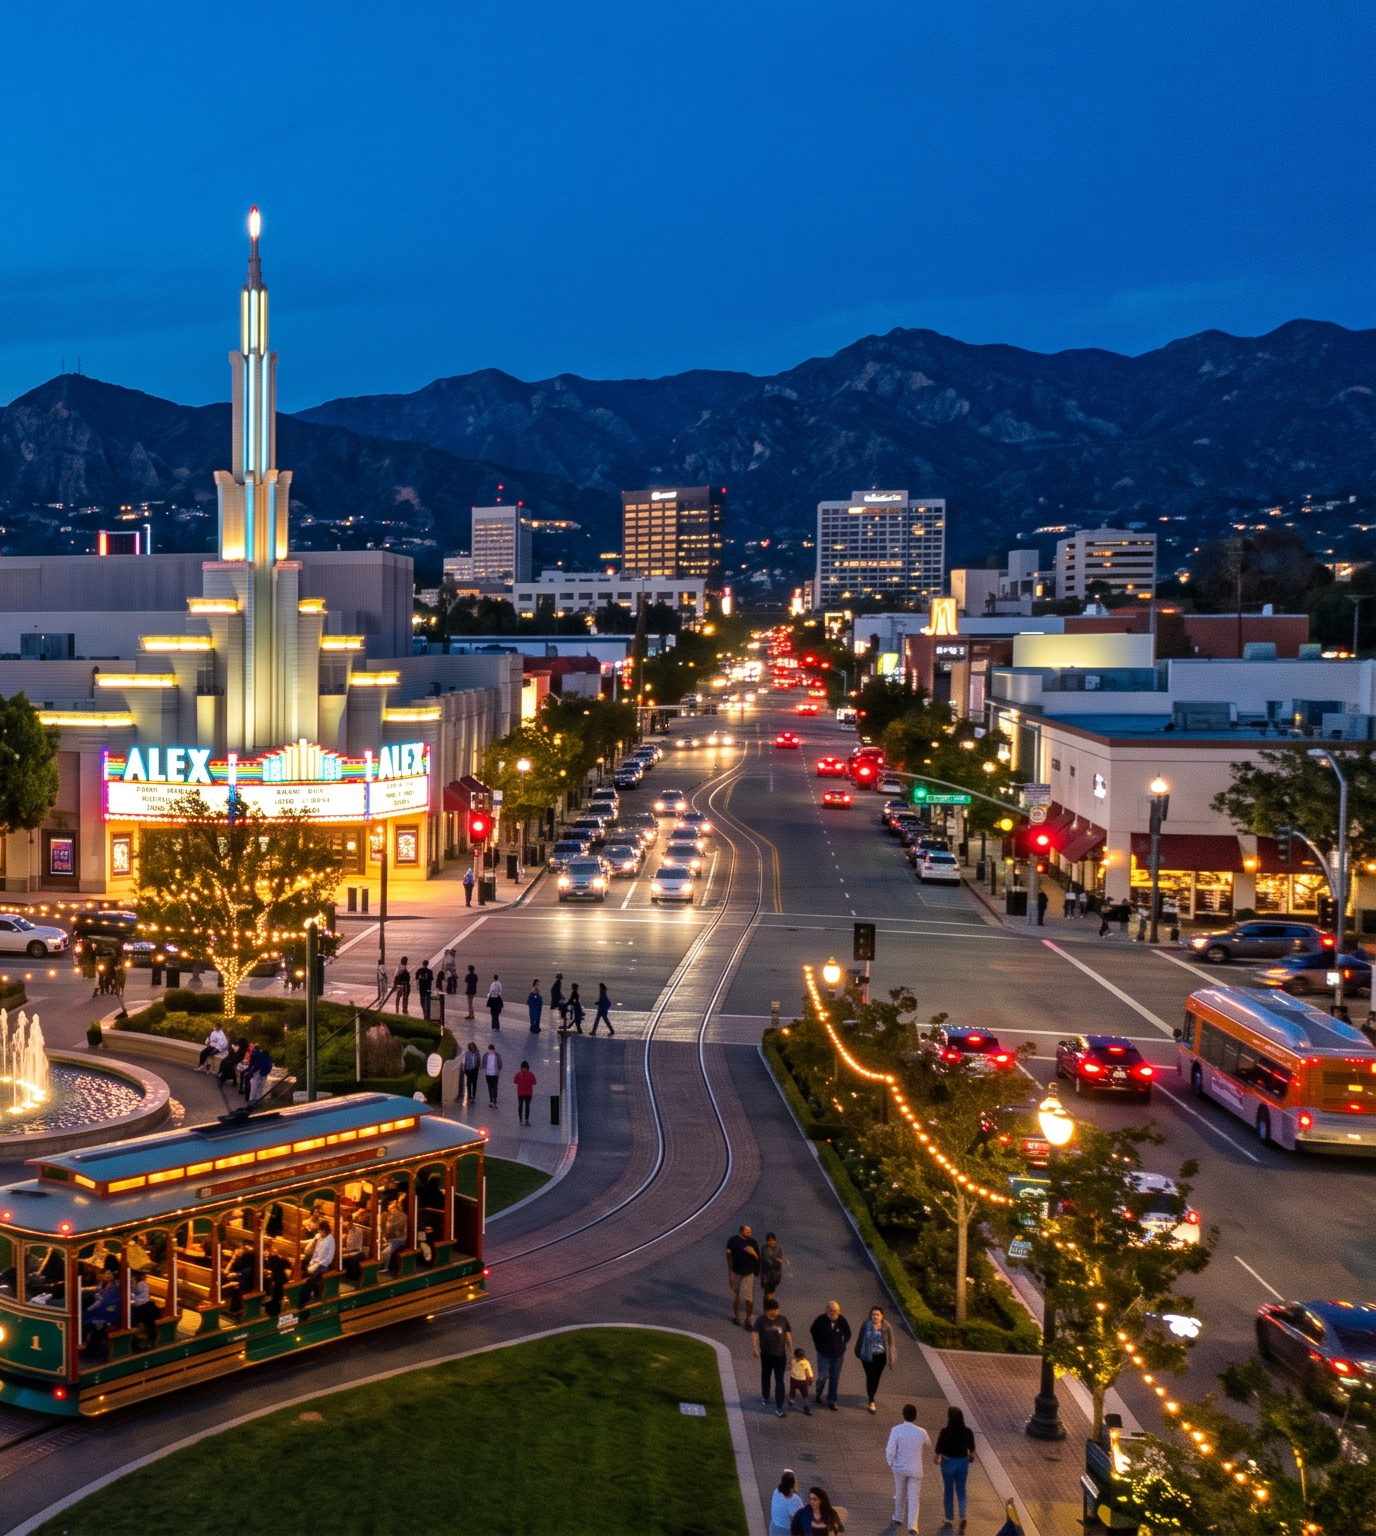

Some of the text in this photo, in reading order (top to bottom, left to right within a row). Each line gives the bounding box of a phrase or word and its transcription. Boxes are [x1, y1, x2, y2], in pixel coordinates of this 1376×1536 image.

[123, 747, 213, 783] ALEX
[379, 742, 425, 779] ALEX
[29, 1335, 42, 1351] 1
